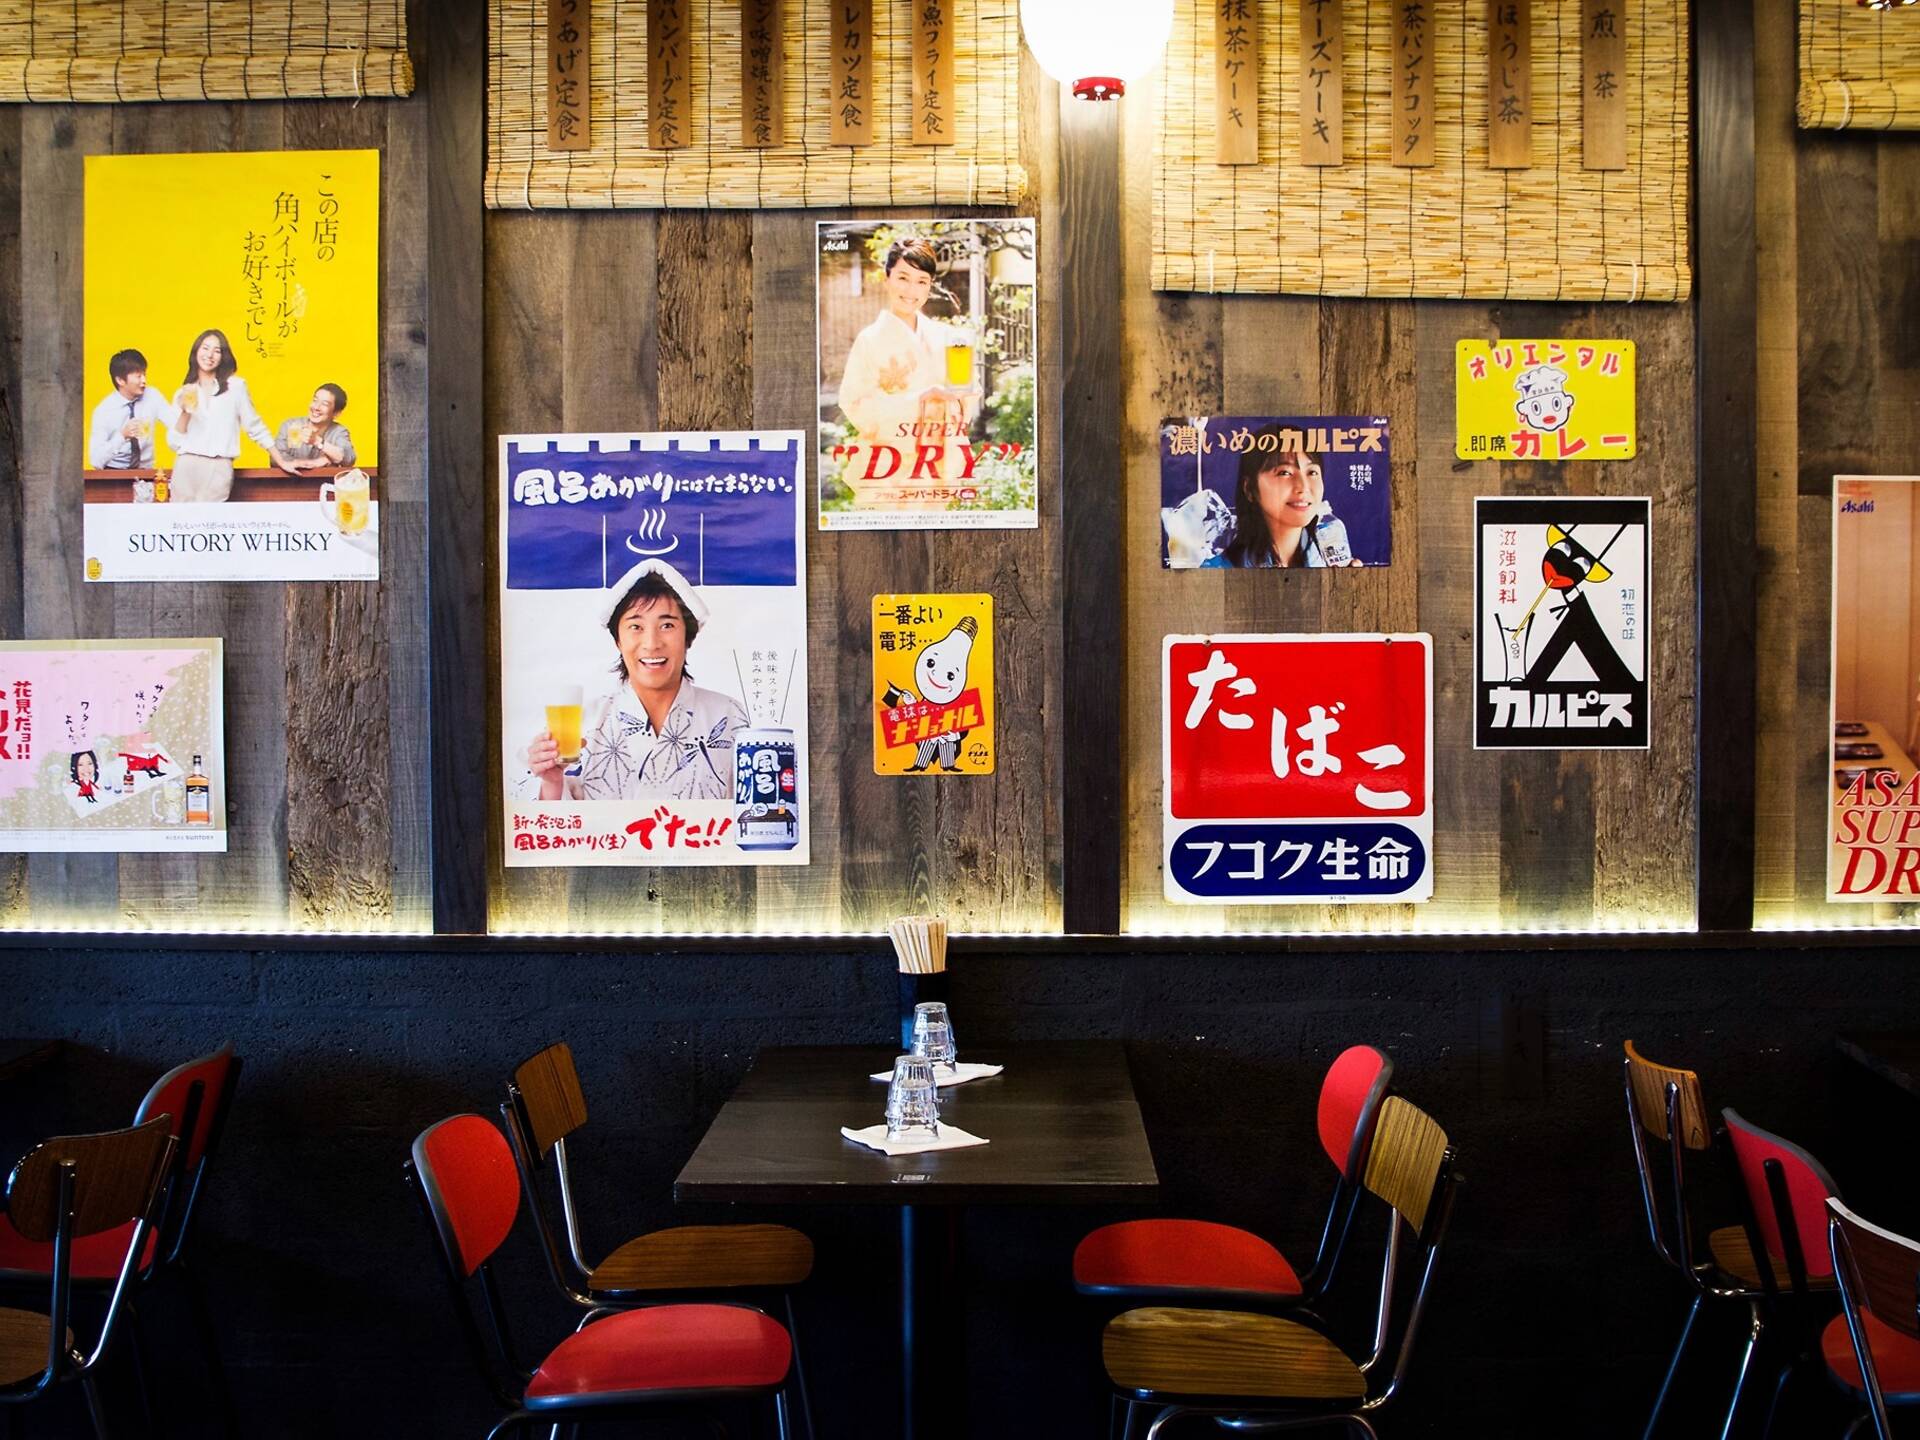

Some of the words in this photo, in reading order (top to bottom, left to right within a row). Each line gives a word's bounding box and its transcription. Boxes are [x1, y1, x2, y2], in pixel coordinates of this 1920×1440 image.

[656, 0, 682, 145] ハンバーグ定食
[921, 0, 944, 135] 魚フライ定食
[1497, 3, 1523, 124] ほうじ茶
[312, 174, 339, 262] この店の
[273, 191, 299, 338] 角ハイボールが
[242, 230, 270, 359] お好きでしょ。
[1469, 343, 1619, 380] オリエンタル
[895, 422, 969, 438] SUPER
[1169, 426, 1383, 455] 濃いめのカルピス
[1471, 435, 1507, 452] 即席
[1510, 428, 1628, 458] カレー
[514, 468, 794, 507] 風呂あがりにはたまらない。
[1841, 499, 1874, 513] Asahi
[128, 532, 236, 553] SUNTORY
[242, 532, 333, 552] WHISKY
[879, 605, 943, 625] 一番よい
[891, 704, 979, 745] ナショナル
[1489, 686, 1633, 728] カルピス
[1184, 649, 1412, 810] たばこ
[752, 749, 781, 794] 風呂
[1185, 837, 1413, 880] フコク生命
